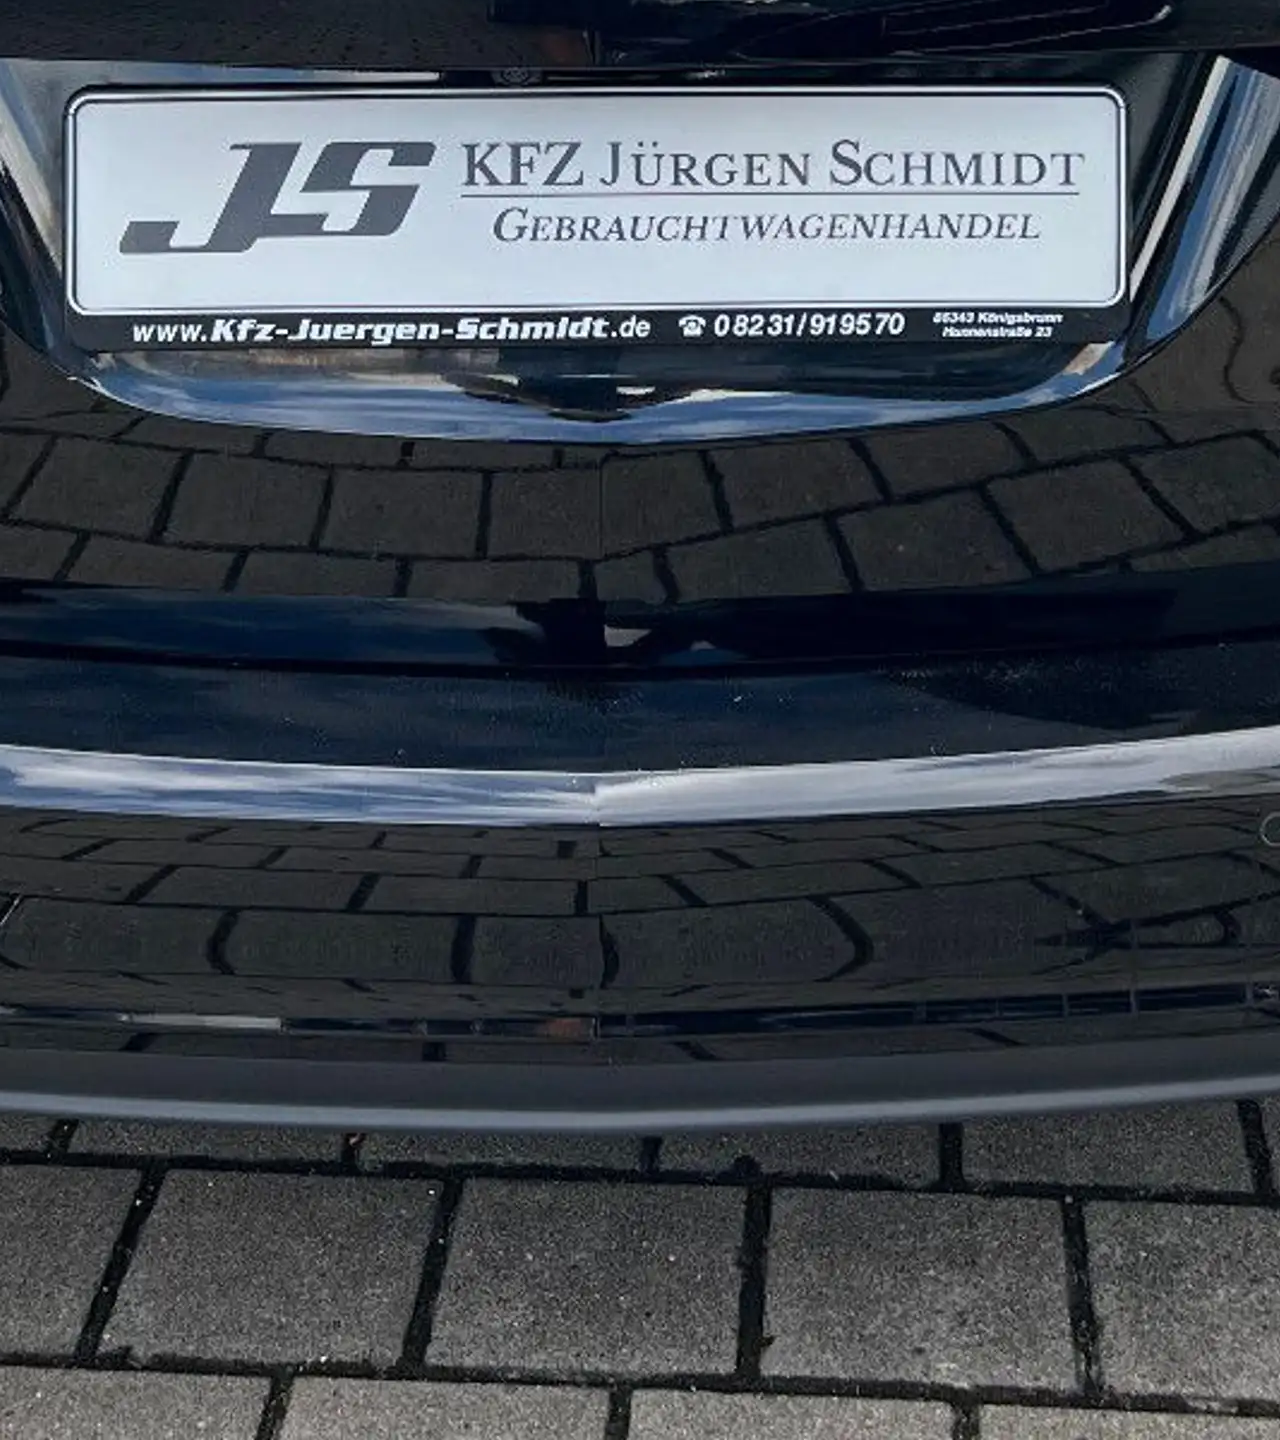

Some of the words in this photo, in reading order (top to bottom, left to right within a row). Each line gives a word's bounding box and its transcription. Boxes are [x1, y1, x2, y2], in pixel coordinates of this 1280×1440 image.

[461, 140, 585, 187] KFZ
[598, 140, 810, 187] JÜRGEN
[829, 139, 1086, 186] SCHMIDT
[119, 141, 437, 253] JS
[492, 206, 1041, 243] GEBRAUCHTWAGENHANDEL
[132, 314, 652, 346] www.Kfz-Juergen-Schmidt.de
[713, 311, 906, 338] 08231/919570
